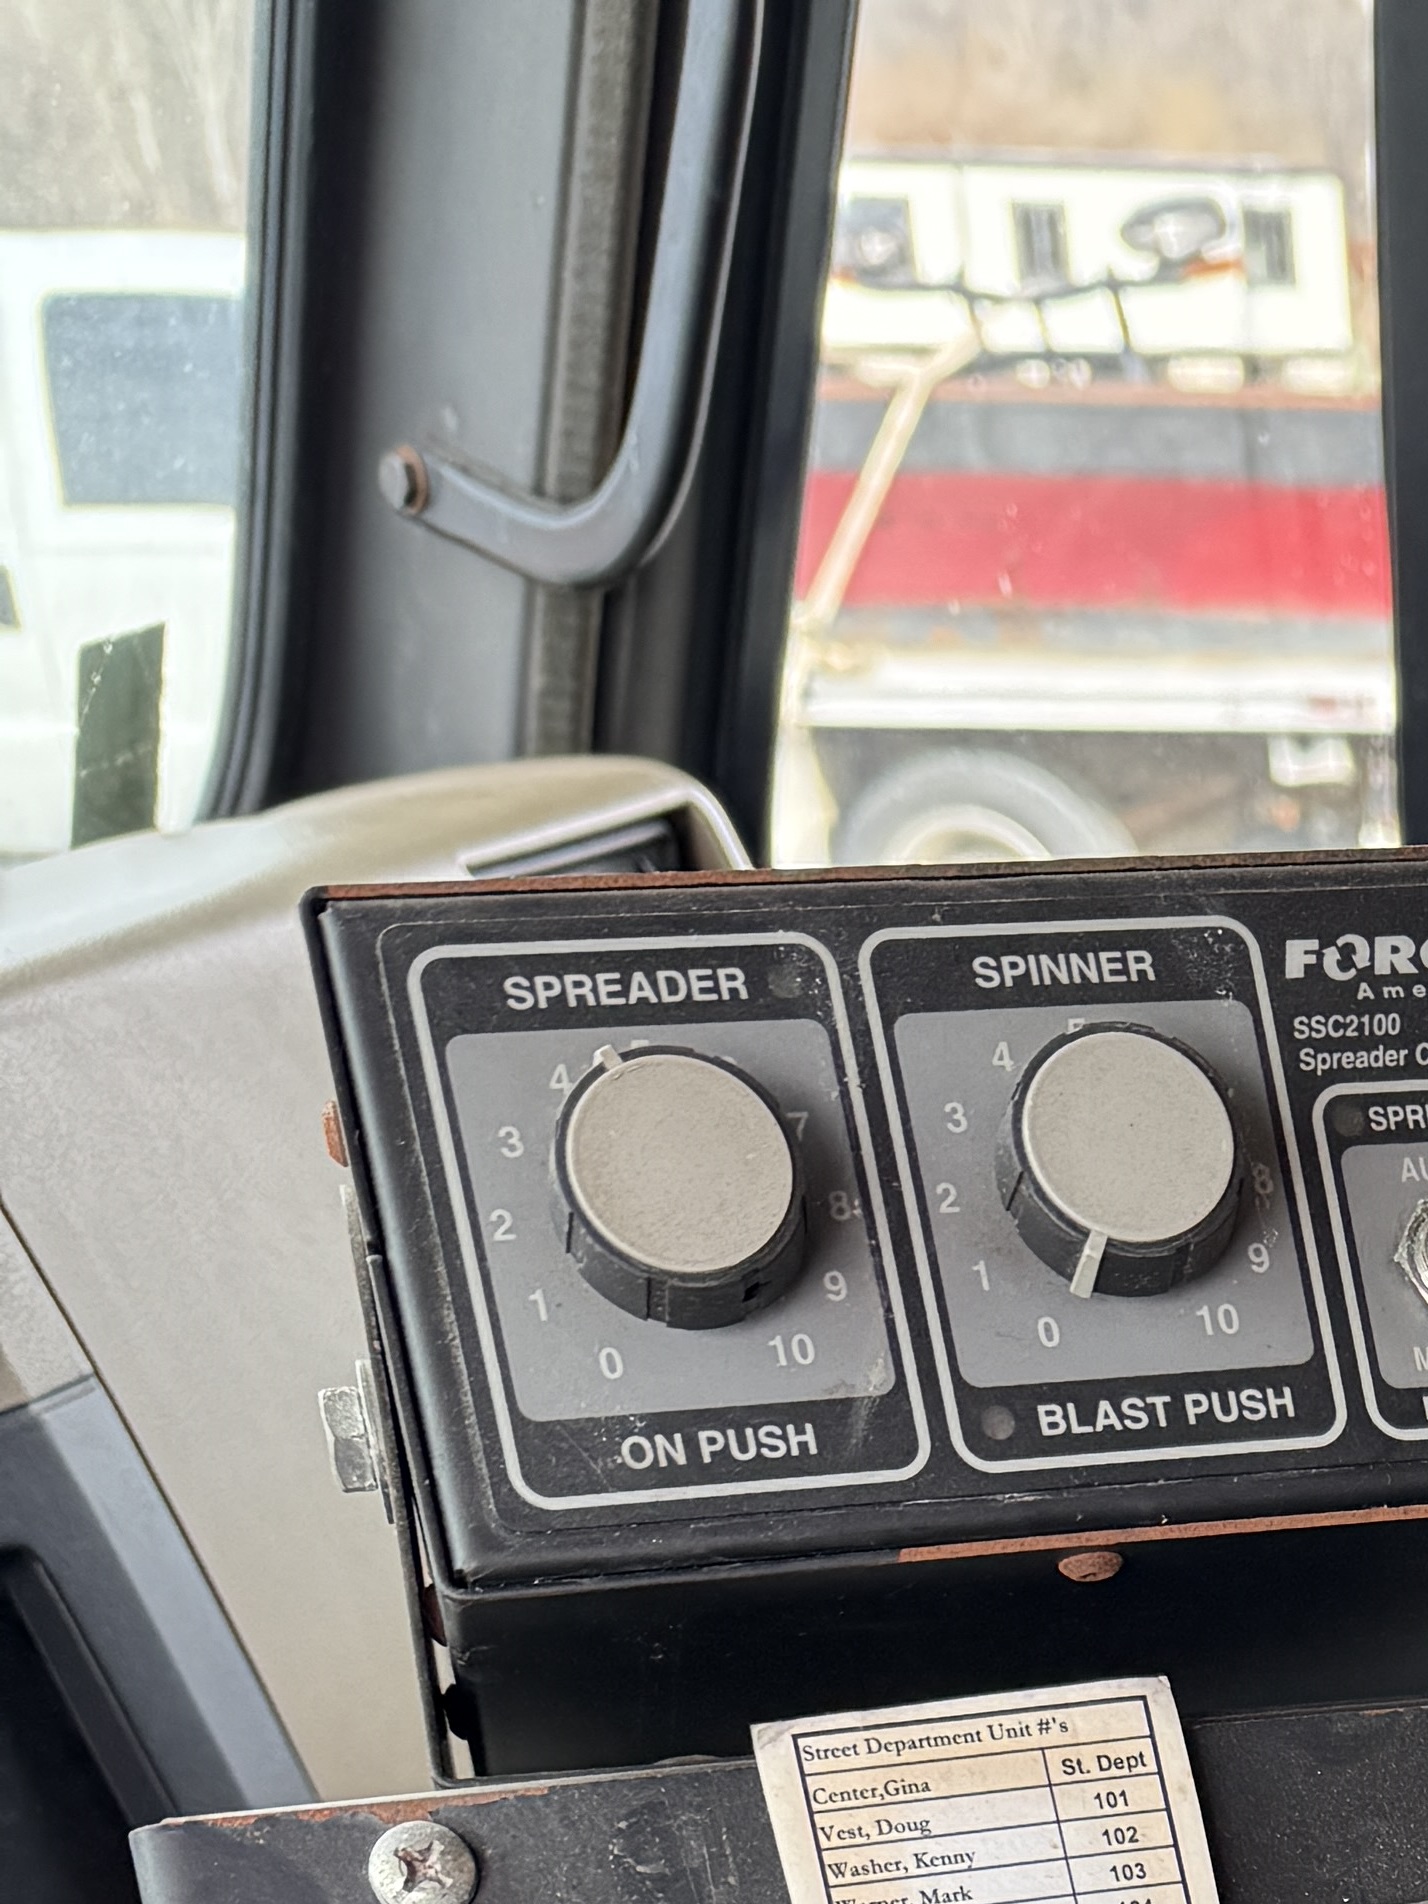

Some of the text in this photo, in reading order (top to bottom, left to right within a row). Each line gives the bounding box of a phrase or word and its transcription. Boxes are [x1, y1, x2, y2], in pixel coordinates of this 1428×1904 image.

[972, 951, 1155, 989] SPINNER
[504, 967, 748, 1010] SPREADER
[1293, 1013, 1401, 1039] SSC2100
[992, 1041, 1014, 1072] 4
[1299, 1045, 1408, 1076] Spreader
[550, 1064, 574, 1095] 4
[786, 1111, 809, 1141] 7
[946, 1102, 968, 1133] 3
[499, 1127, 524, 1159] 3
[828, 1190, 851, 1221] 8
[936, 1183, 960, 1214] 2
[490, 1211, 516, 1241] 2
[1248, 1243, 1271, 1273] 9
[824, 1272, 848, 1302] 9
[971, 1261, 991, 1290] 1
[529, 1290, 548, 1322] 1
[1196, 1303, 1239, 1337] 10
[1037, 1317, 1061, 1347] 0
[600, 1347, 624, 1380] 0
[769, 1334, 815, 1369] 10
[1036, 1387, 1295, 1437] BLAST PUSH
[621, 1424, 818, 1469] ON PUSH
[802, 1717, 1069, 1762] Street Department Unit #'s
[1062, 1750, 1148, 1776] St. Dept
[813, 1778, 931, 1804] Center,Gina
[1094, 1790, 1130, 1809] 101
[820, 1817, 931, 1841] Vest, Doug
[1102, 1826, 1138, 1846] 102
[828, 1848, 975, 1879] Washer, Kenny
[1110, 1863, 1146, 1882] 103
